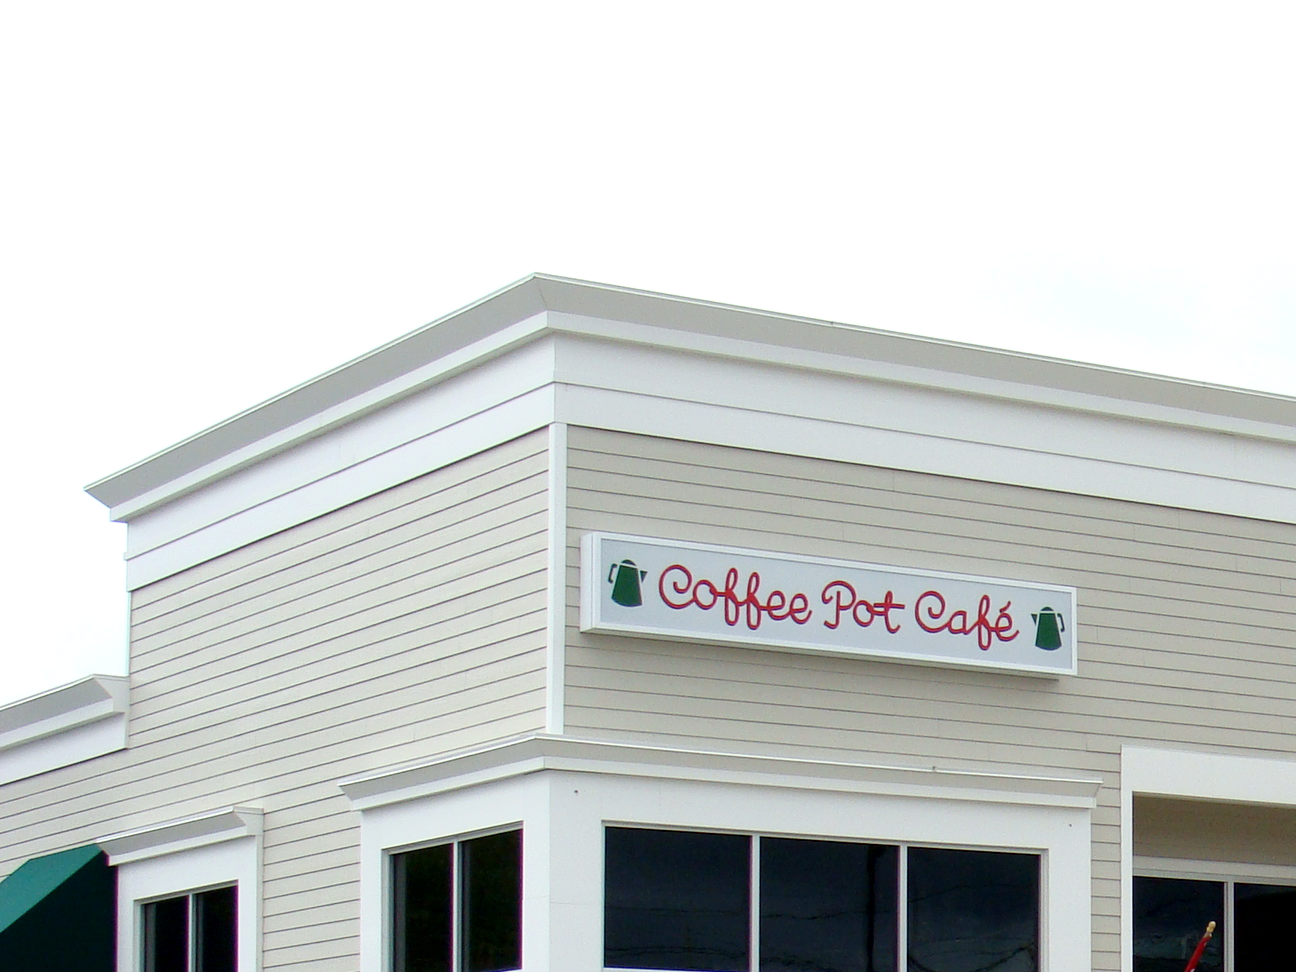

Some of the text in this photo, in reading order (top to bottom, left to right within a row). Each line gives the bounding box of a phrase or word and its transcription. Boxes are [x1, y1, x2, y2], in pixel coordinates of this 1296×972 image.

[658, 564, 1020, 651] Coffee Pot Café
